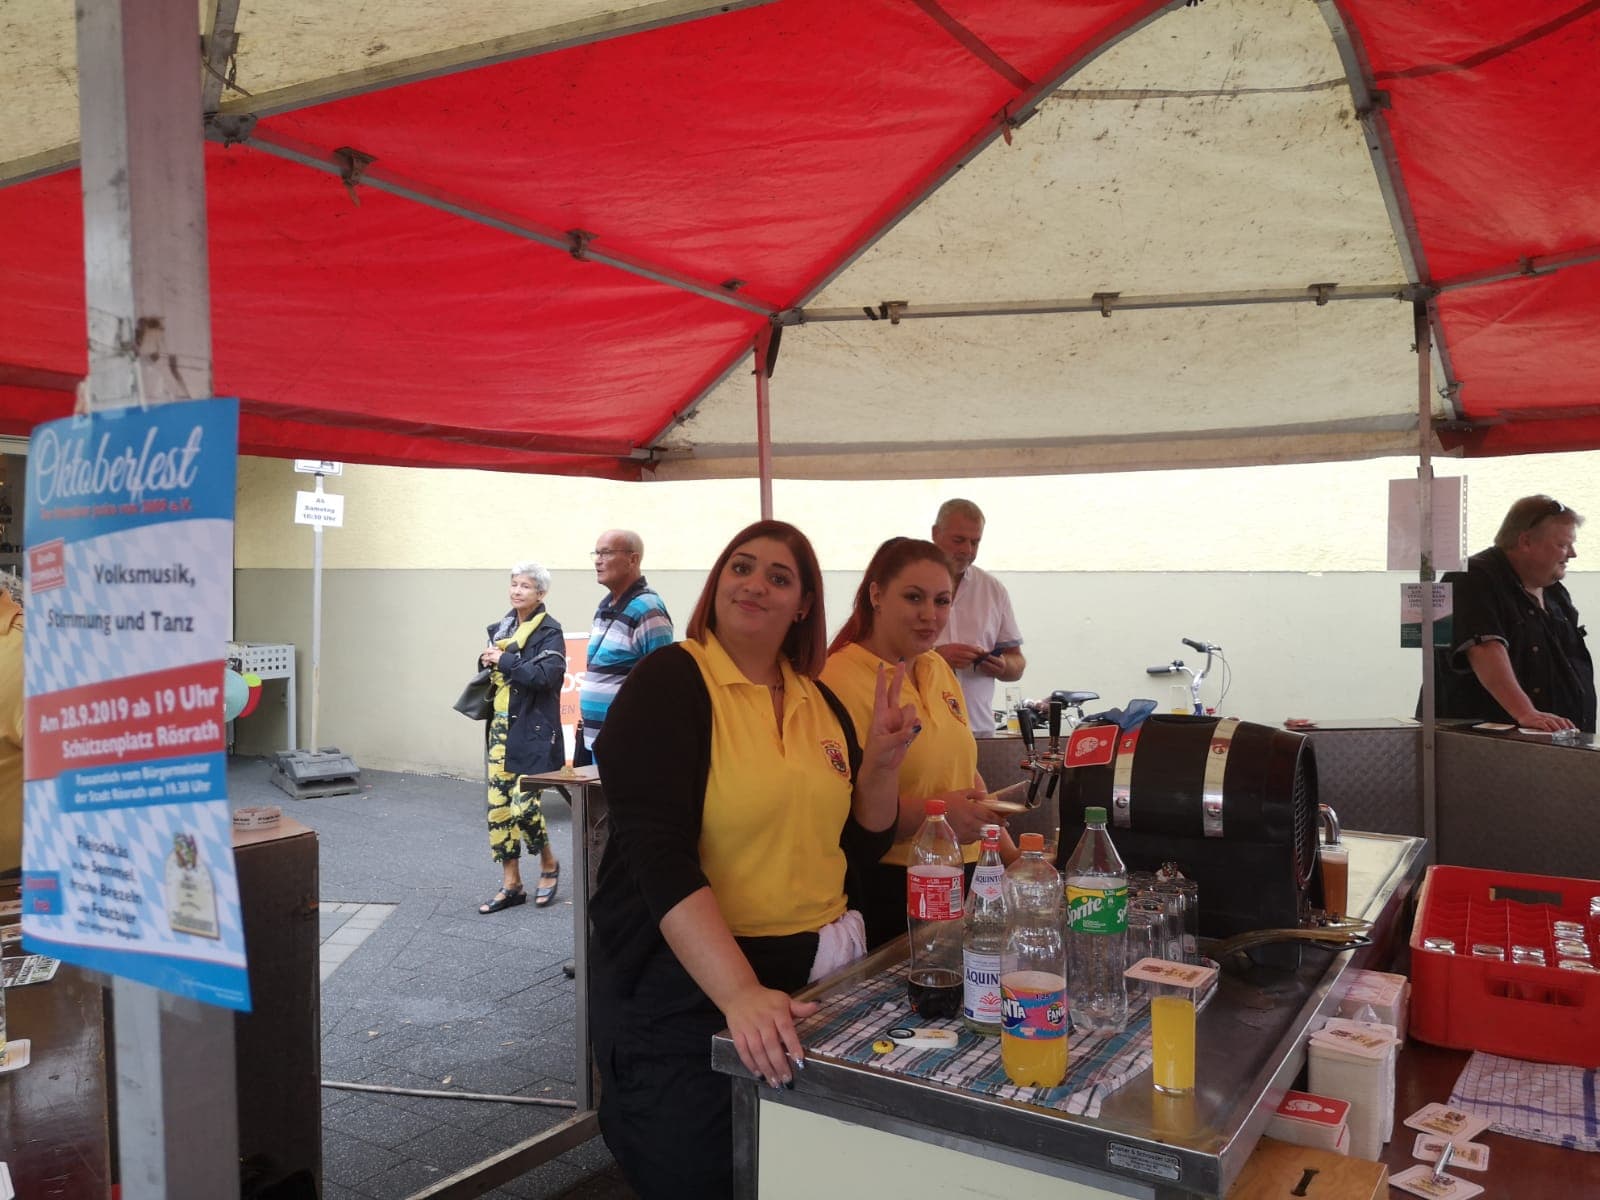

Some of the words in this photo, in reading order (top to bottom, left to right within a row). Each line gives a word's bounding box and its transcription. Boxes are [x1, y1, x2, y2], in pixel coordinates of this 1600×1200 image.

[304, 505, 336, 514] Samstag
[93, 563, 196, 588] Volksmusik,
[47, 608, 111, 636] Stimmung
[115, 610, 145, 632] und
[150, 610, 195, 633] Tanz
[39, 714, 59, 733] Am
[60, 696, 129, 730] 28.9.2019
[132, 698, 151, 719] ab
[155, 689, 175, 715] 19
[179, 684, 220, 710] Uhr
[62, 730, 154, 758] Schützenplatz
[156, 720, 220, 747] Rösrath
[190, 779, 212, 793] Uhr
[1067, 897, 1103, 928] Sprite
[966, 967, 1001, 985] AQUIN
